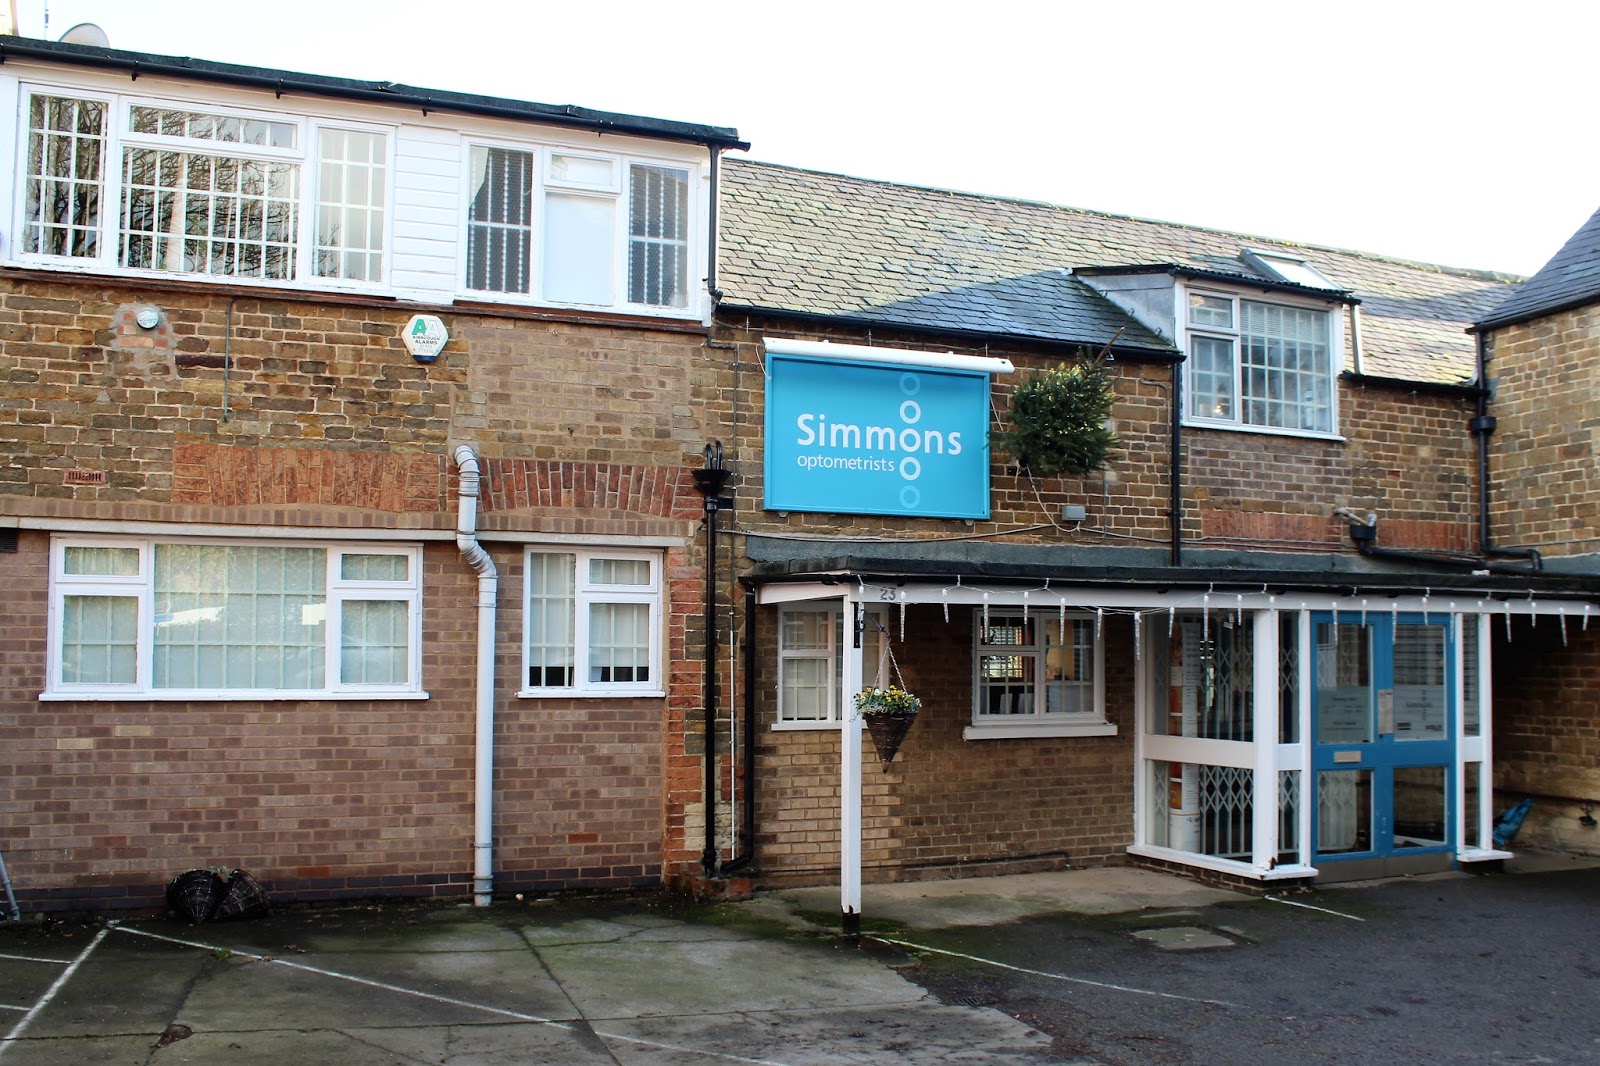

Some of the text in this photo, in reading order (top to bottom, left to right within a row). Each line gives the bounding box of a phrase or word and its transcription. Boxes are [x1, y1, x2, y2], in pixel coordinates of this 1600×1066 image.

[797, 413, 962, 456] Simmons
[797, 454, 895, 472] optometrists
[880, 586, 897, 601] 23
